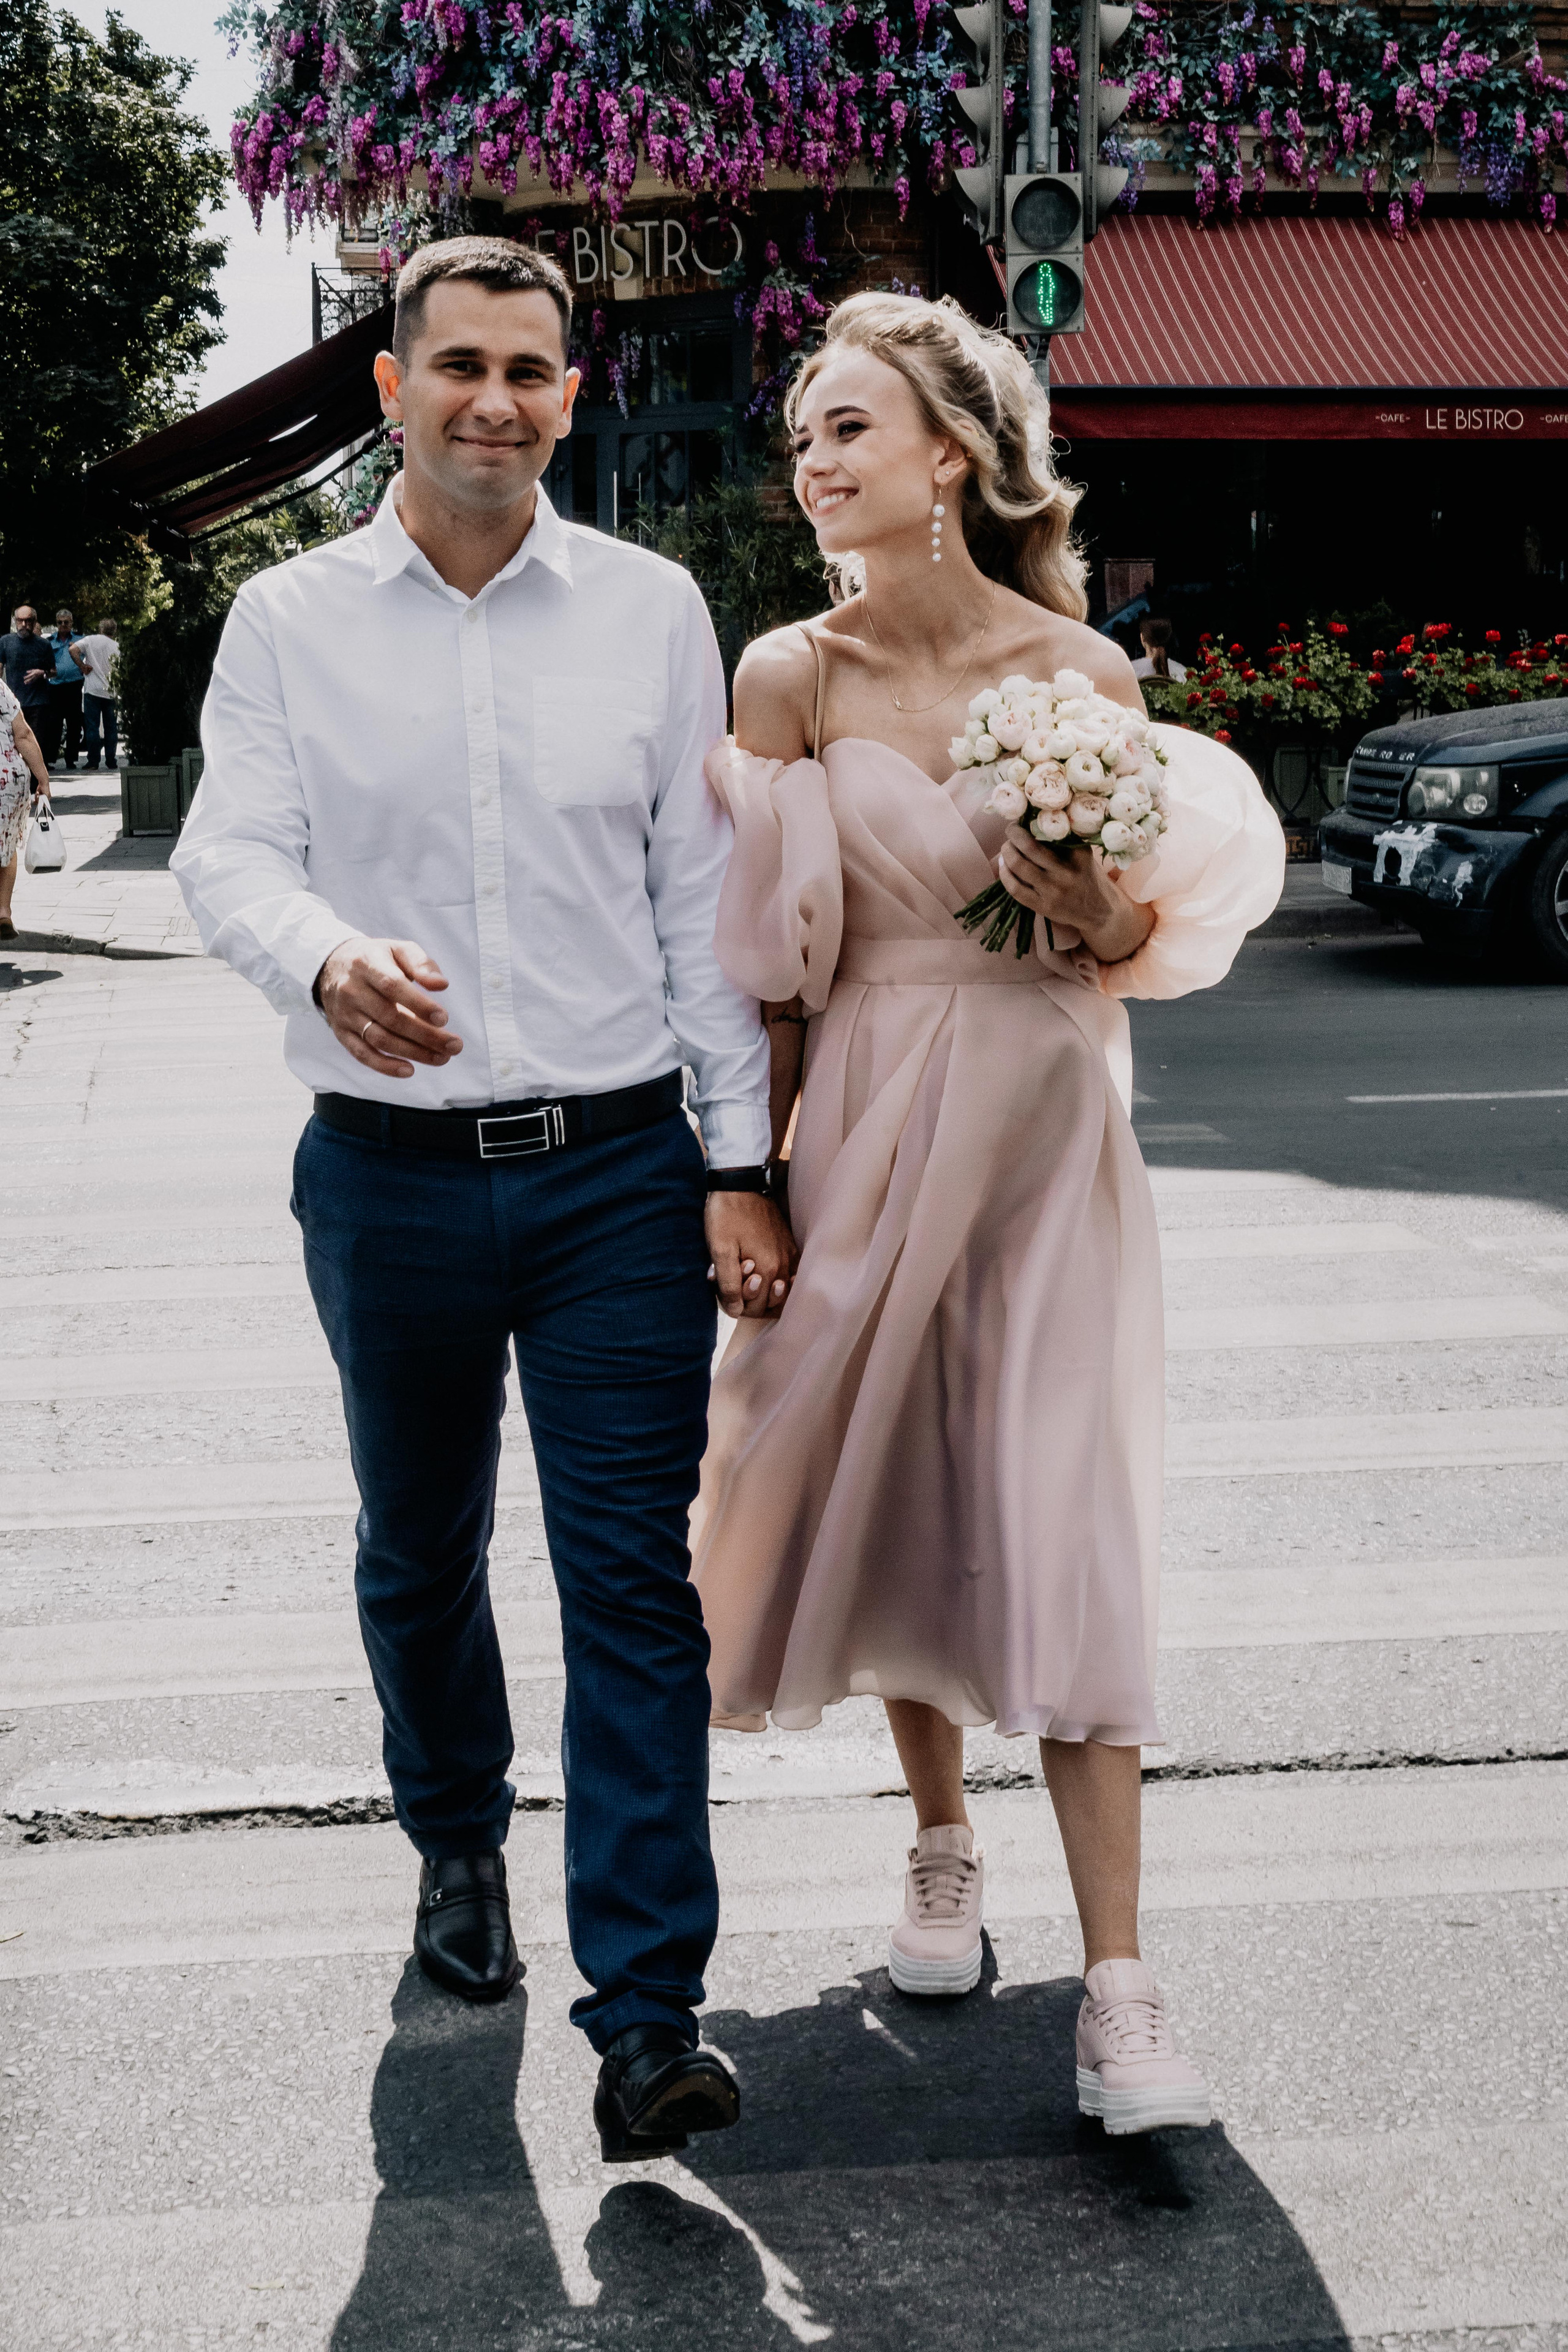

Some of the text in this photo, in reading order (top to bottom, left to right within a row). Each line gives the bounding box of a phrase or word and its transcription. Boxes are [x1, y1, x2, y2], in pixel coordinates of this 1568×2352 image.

[573, 216, 742, 284] BISTRO
[1426, 409, 1447, 429] LE
[1455, 409, 1523, 429] BISTRO
